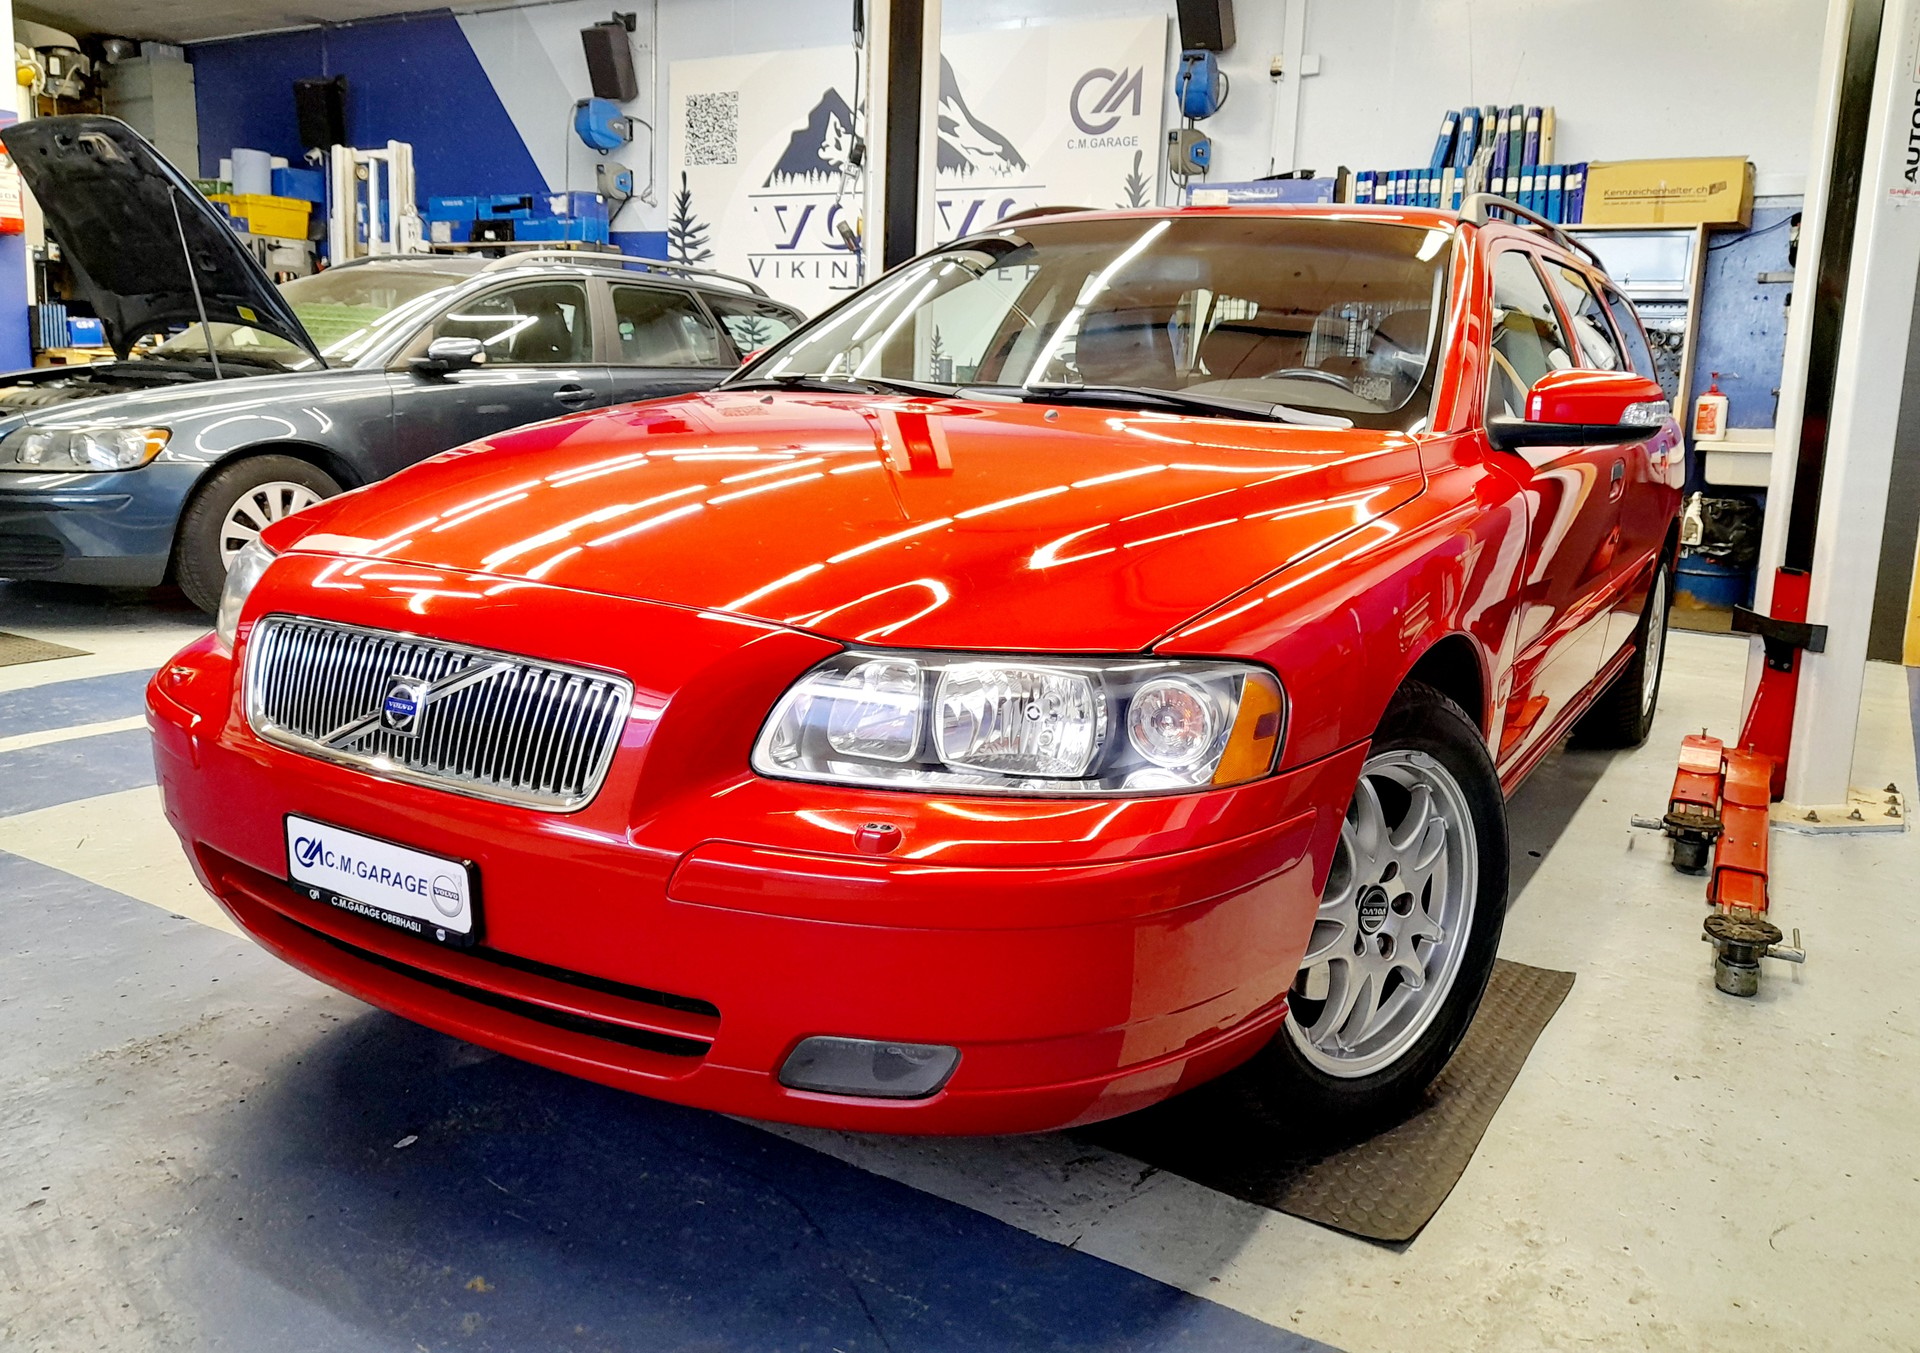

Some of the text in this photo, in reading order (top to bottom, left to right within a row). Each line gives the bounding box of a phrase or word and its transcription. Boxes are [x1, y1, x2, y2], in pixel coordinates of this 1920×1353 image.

[1067, 136, 1139, 150] C.M.GARAGE
[1603, 186, 1708, 197] Kennzeichenhalter.ch
[748, 257, 862, 279] VIKIN
[389, 701, 414, 711] VOLVO
[325, 851, 428, 896] C.M.GARAGE
[434, 888, 458, 900] VOLVO
[331, 896, 381, 920] C.M.GARAGE
[381, 912, 422, 933] OBERHASLI
